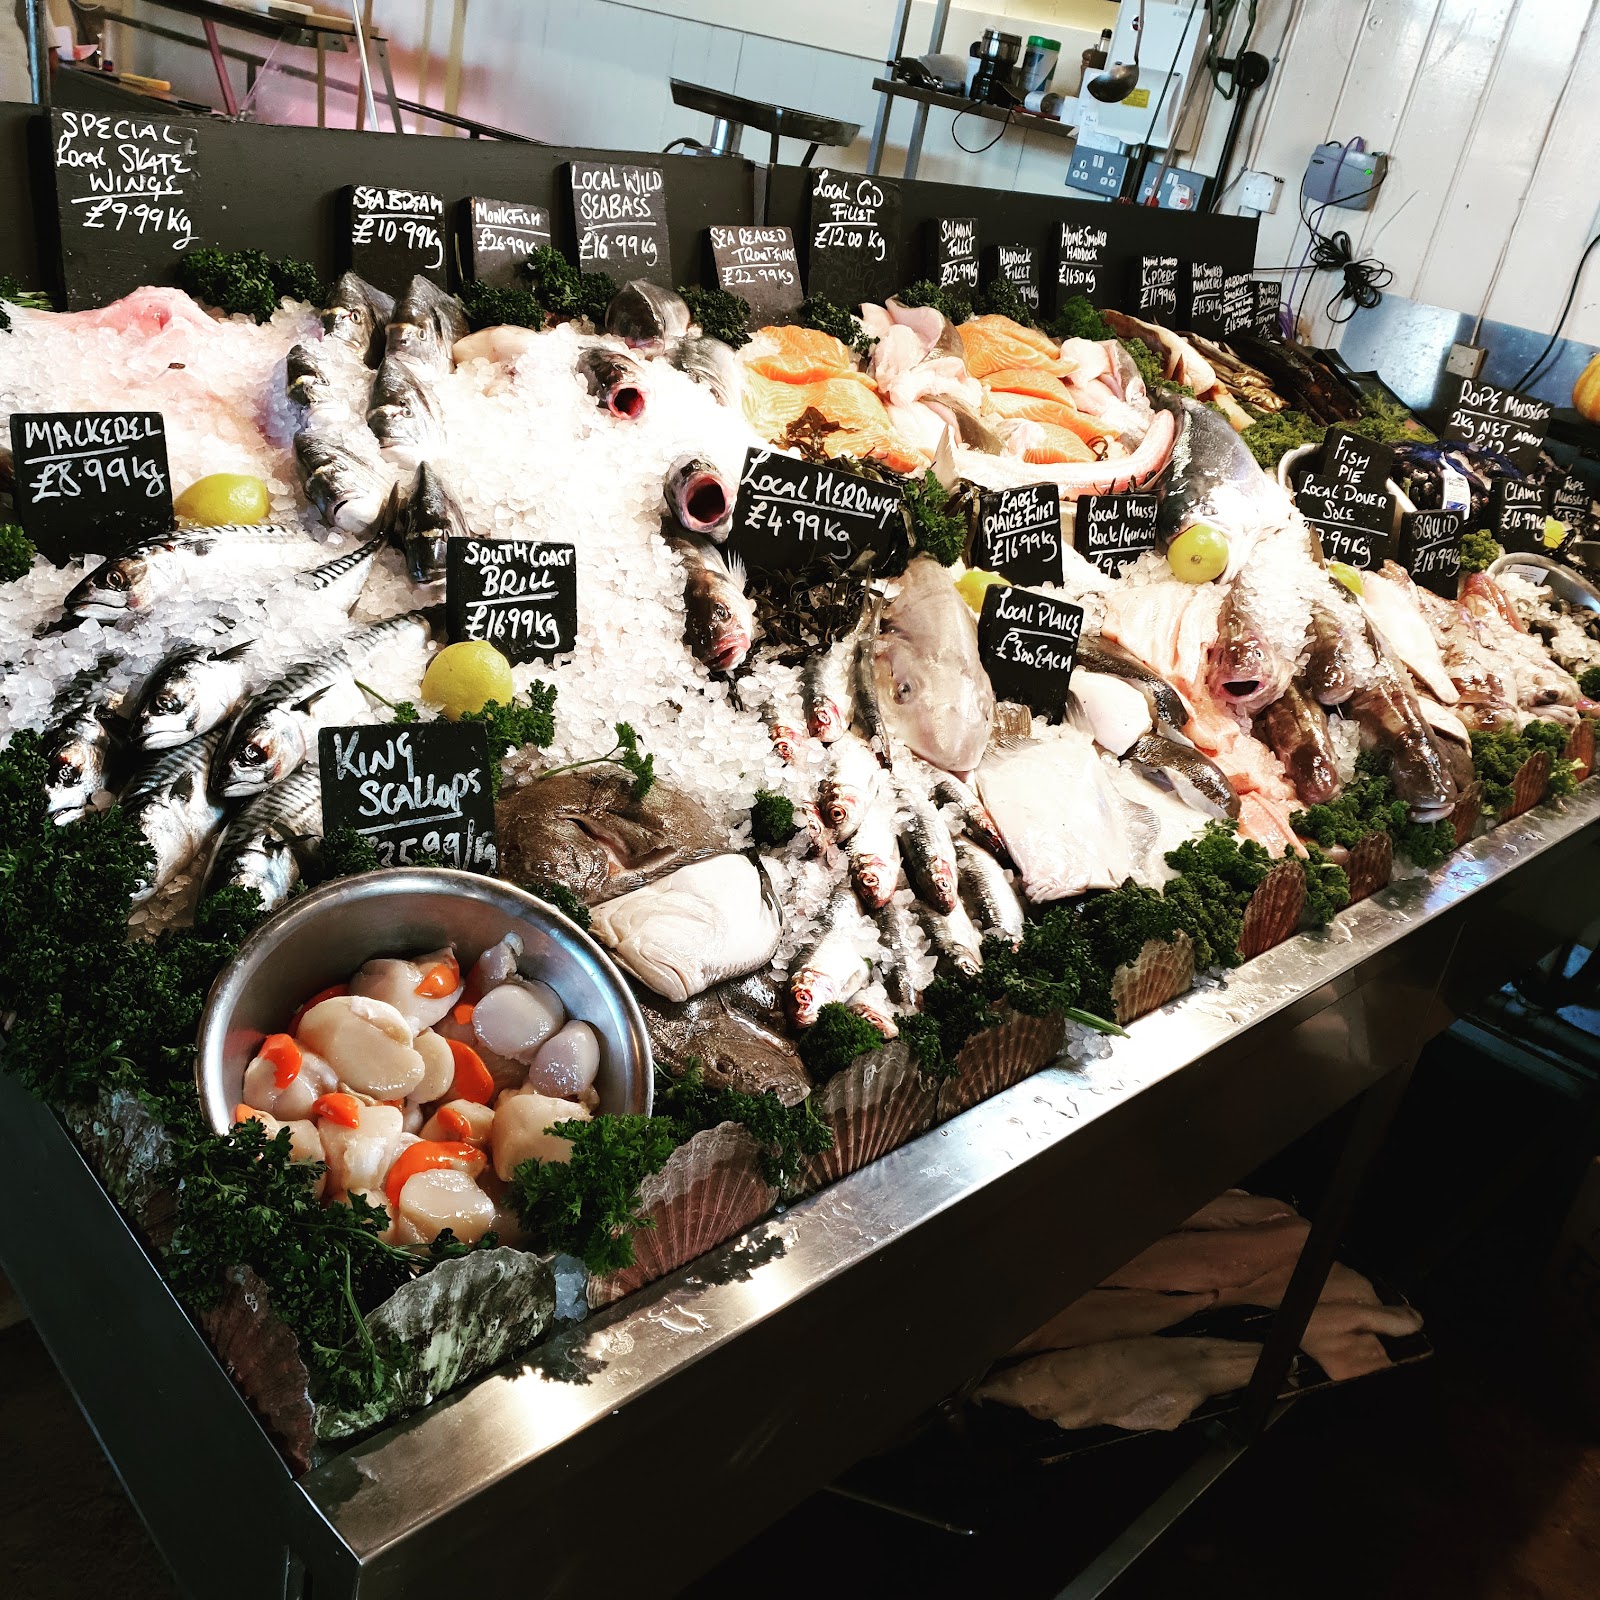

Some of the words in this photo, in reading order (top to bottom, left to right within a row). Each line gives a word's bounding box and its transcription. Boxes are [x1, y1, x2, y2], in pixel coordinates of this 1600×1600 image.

[62, 112, 181, 144] SPECIAL
[118, 144, 191, 175] SKATE
[90, 169, 176, 201] WINGS
[571, 165, 620, 190] LOCAL
[623, 170, 662, 195] WILD
[857, 180, 884, 207] COD
[580, 192, 651, 219] SEABASS
[710, 227, 735, 249] SEA
[739, 228, 786, 246] REARED
[940, 220, 973, 242] SALMON
[1459, 379, 1503, 414] ROPE
[24, 417, 161, 454] MACKEREL
[1478, 421, 1511, 438] NET
[1334, 435, 1370, 469] FISH
[1338, 464, 1365, 483] PIE
[999, 487, 1039, 514] LARGE
[1344, 484, 1388, 509] DOVER
[1505, 482, 1544, 502] CLAMS
[1323, 499, 1355, 521] SOLE
[1413, 515, 1459, 539] SQUID
[464, 541, 528, 565] SOUTH
[529, 542, 573, 568] COAST
[480, 565, 555, 596] BRILL
